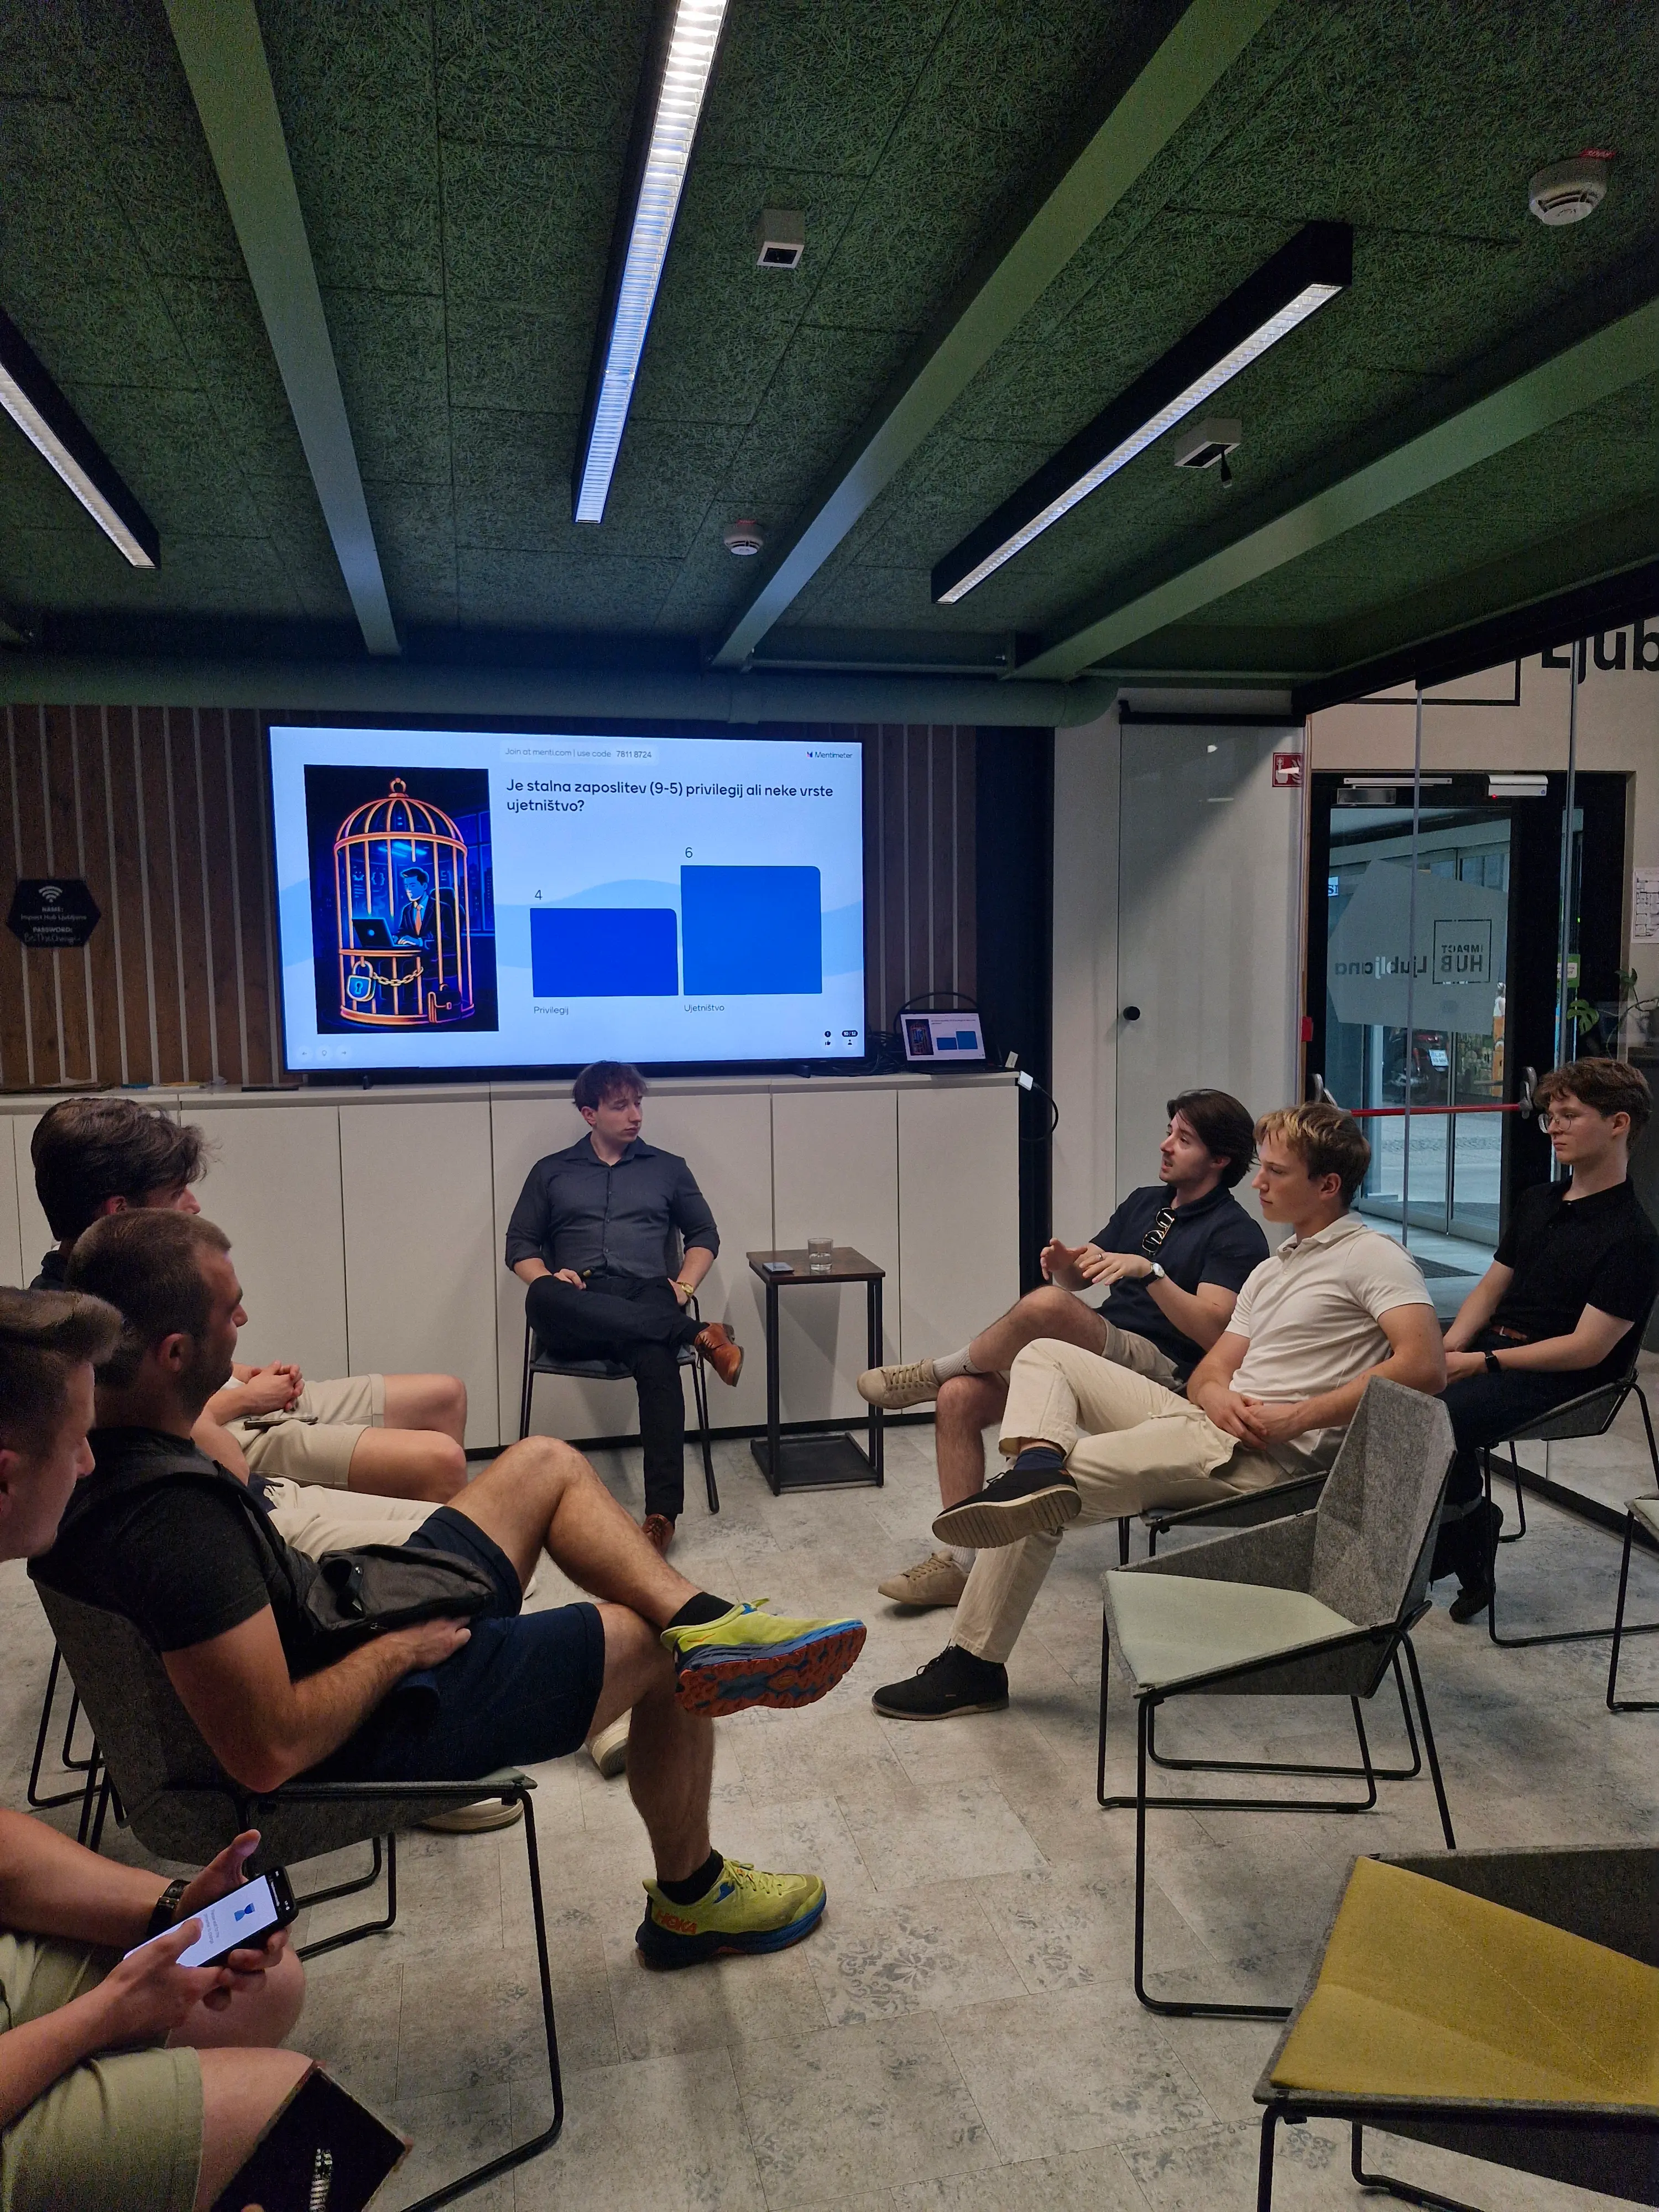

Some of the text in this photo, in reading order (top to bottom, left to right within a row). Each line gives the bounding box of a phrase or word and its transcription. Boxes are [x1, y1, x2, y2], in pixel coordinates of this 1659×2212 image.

[507, 779, 833, 798] Je stalna zaposlitev (9-5) privilegij ali neke vrste
[507, 800, 585, 813] ujetništvo?
[685, 847, 693, 858] 6
[534, 889, 543, 900] 4
[533, 1006, 570, 1015] Privilegij
[684, 1004, 726, 1013] Ujetništvo
